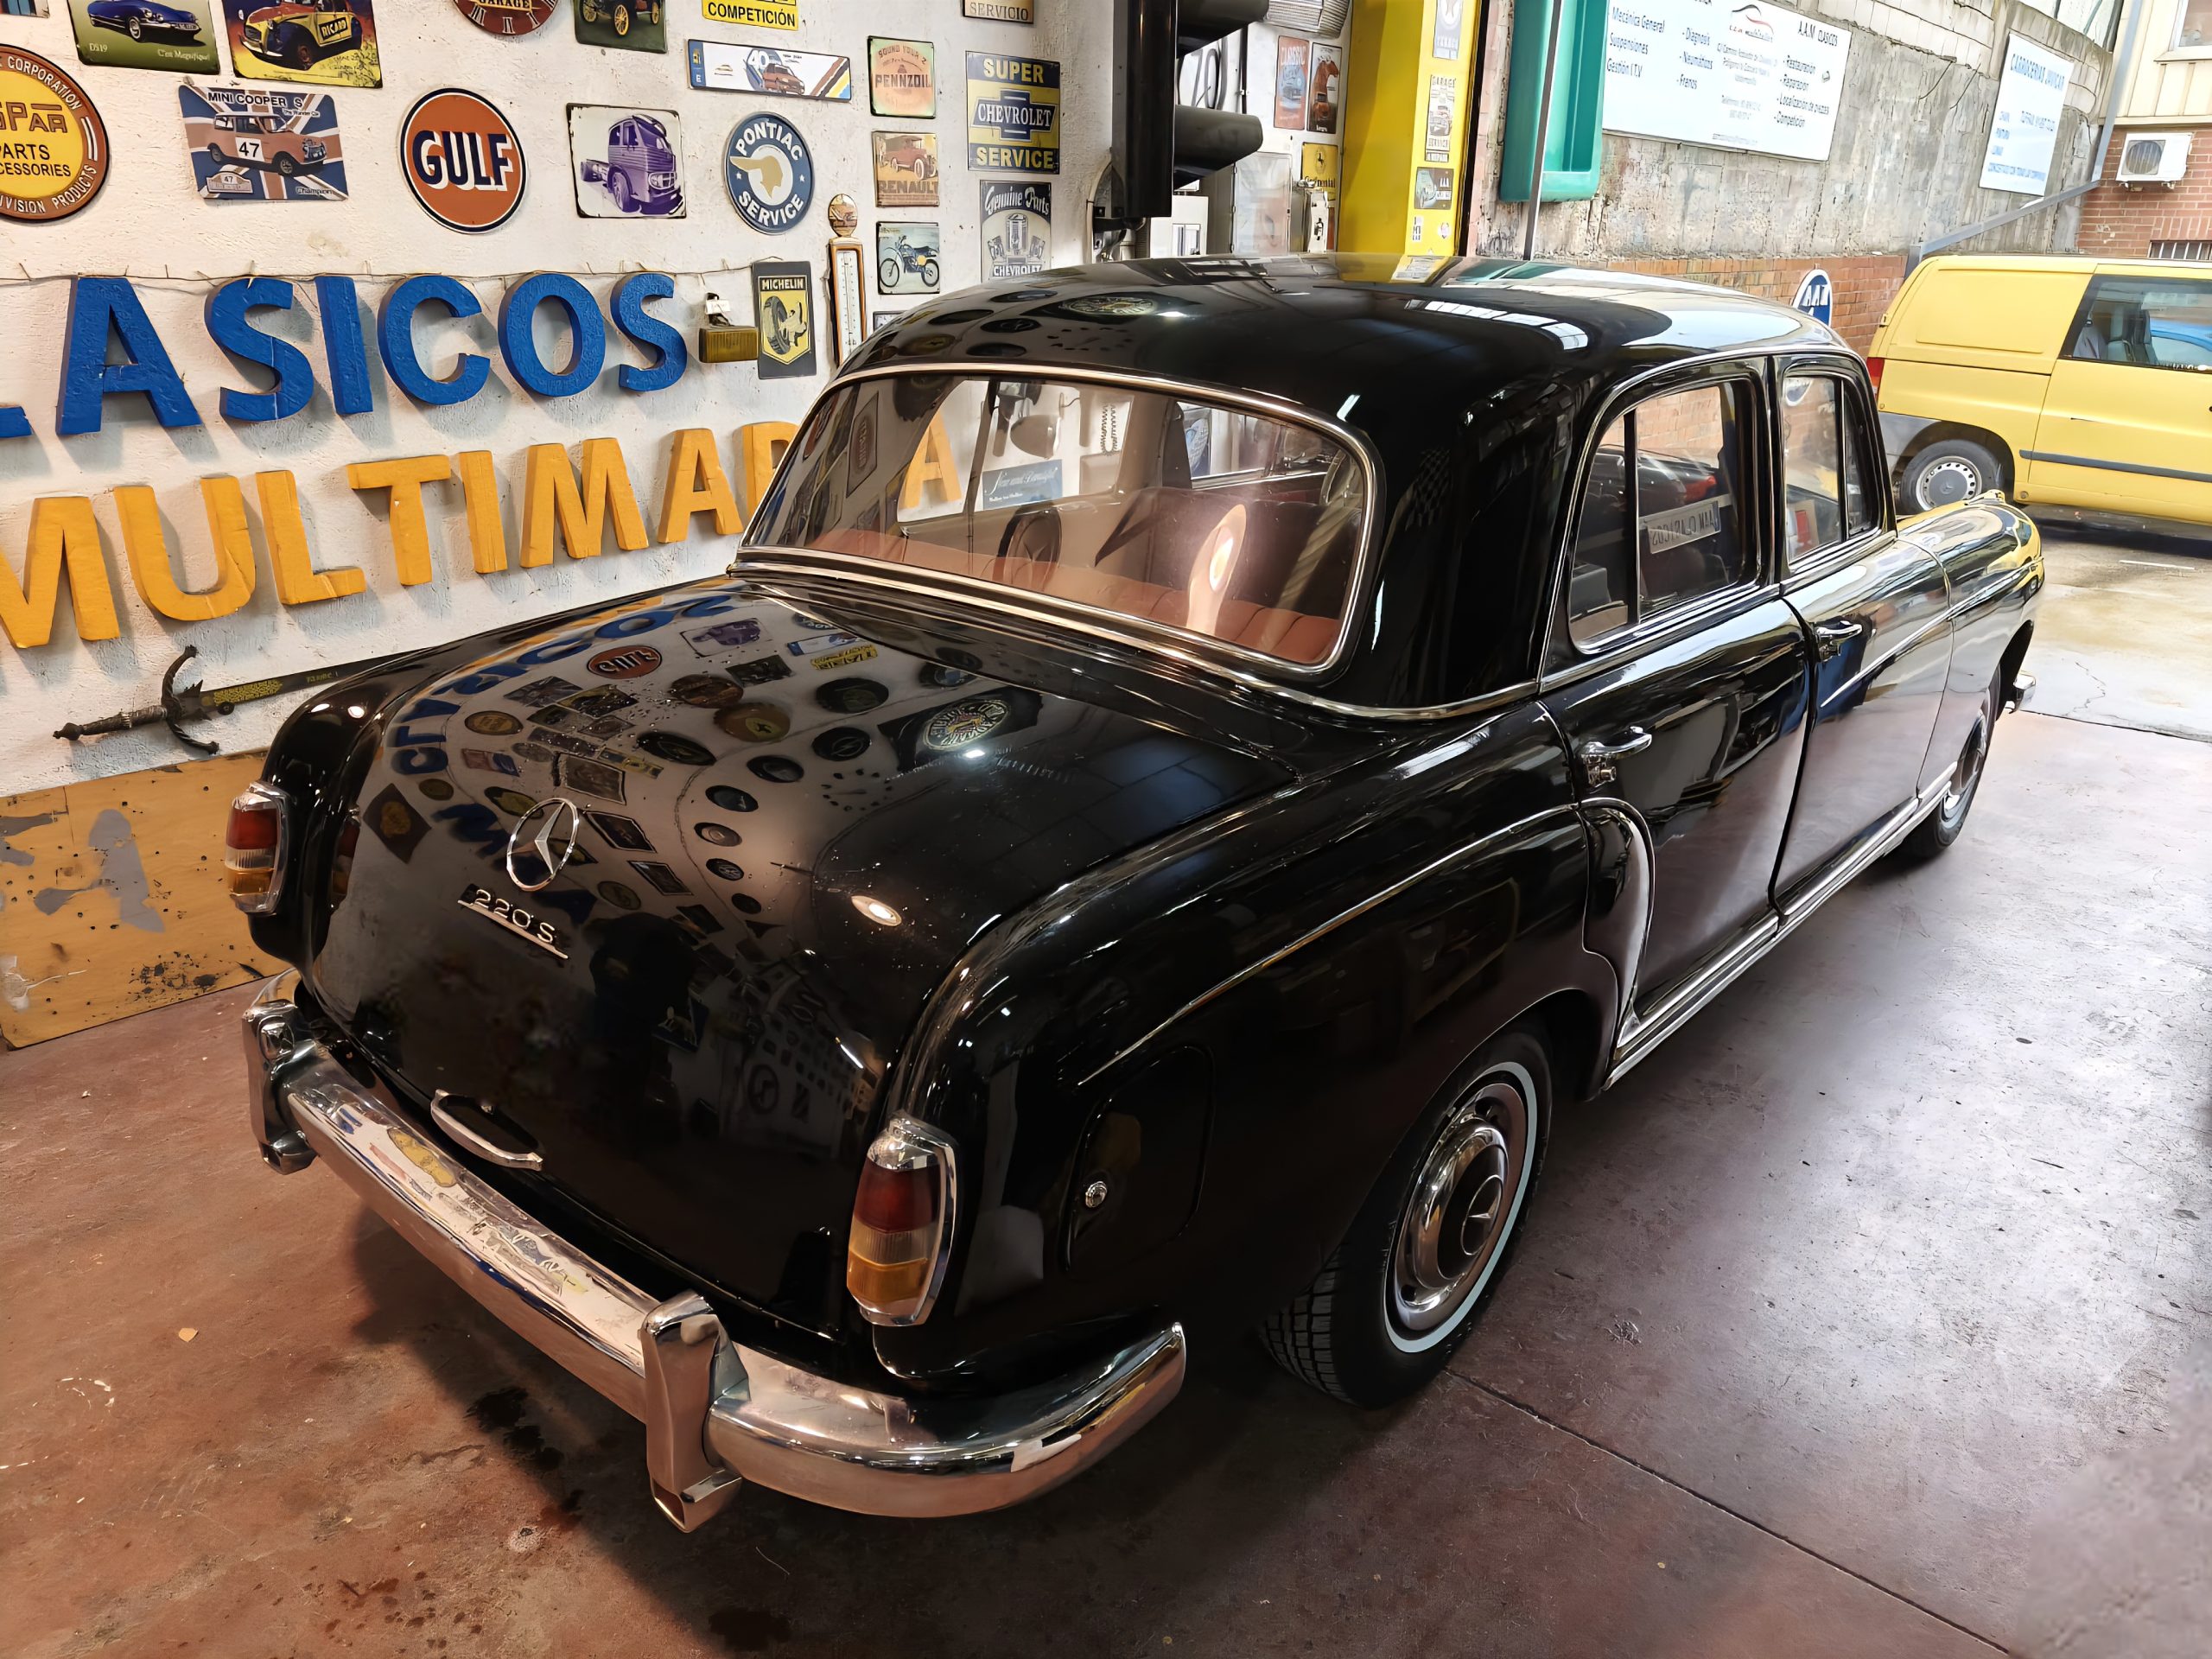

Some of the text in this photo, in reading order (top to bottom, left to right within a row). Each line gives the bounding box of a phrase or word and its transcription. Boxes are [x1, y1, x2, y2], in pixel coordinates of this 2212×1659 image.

[708, 2, 796, 28] COMPETICIÓN
[969, 2, 1029, 21] SERVICIO
[8, 55, 83, 111] CORPORATION
[874, 73, 931, 88] PENNZOIL
[983, 58, 1045, 84] SUPER
[207, 92, 302, 108] MINI COOPER S
[977, 103, 1052, 127] CHEVROLET
[238, 142, 260, 158] 47
[735, 121, 803, 161] PONTIAC
[411, 130, 513, 192] GULF
[976, 146, 1054, 169] SERVICE
[51, 164, 97, 209] PRODUCTS
[223, 175, 233, 183] 47
[877, 180, 938, 194] RENAULT
[738, 190, 804, 227] SERVICE
[984, 185, 1023, 216] Genuine
[761, 278, 804, 290] MICHELIN
[474, 888, 556, 944] 220 S
